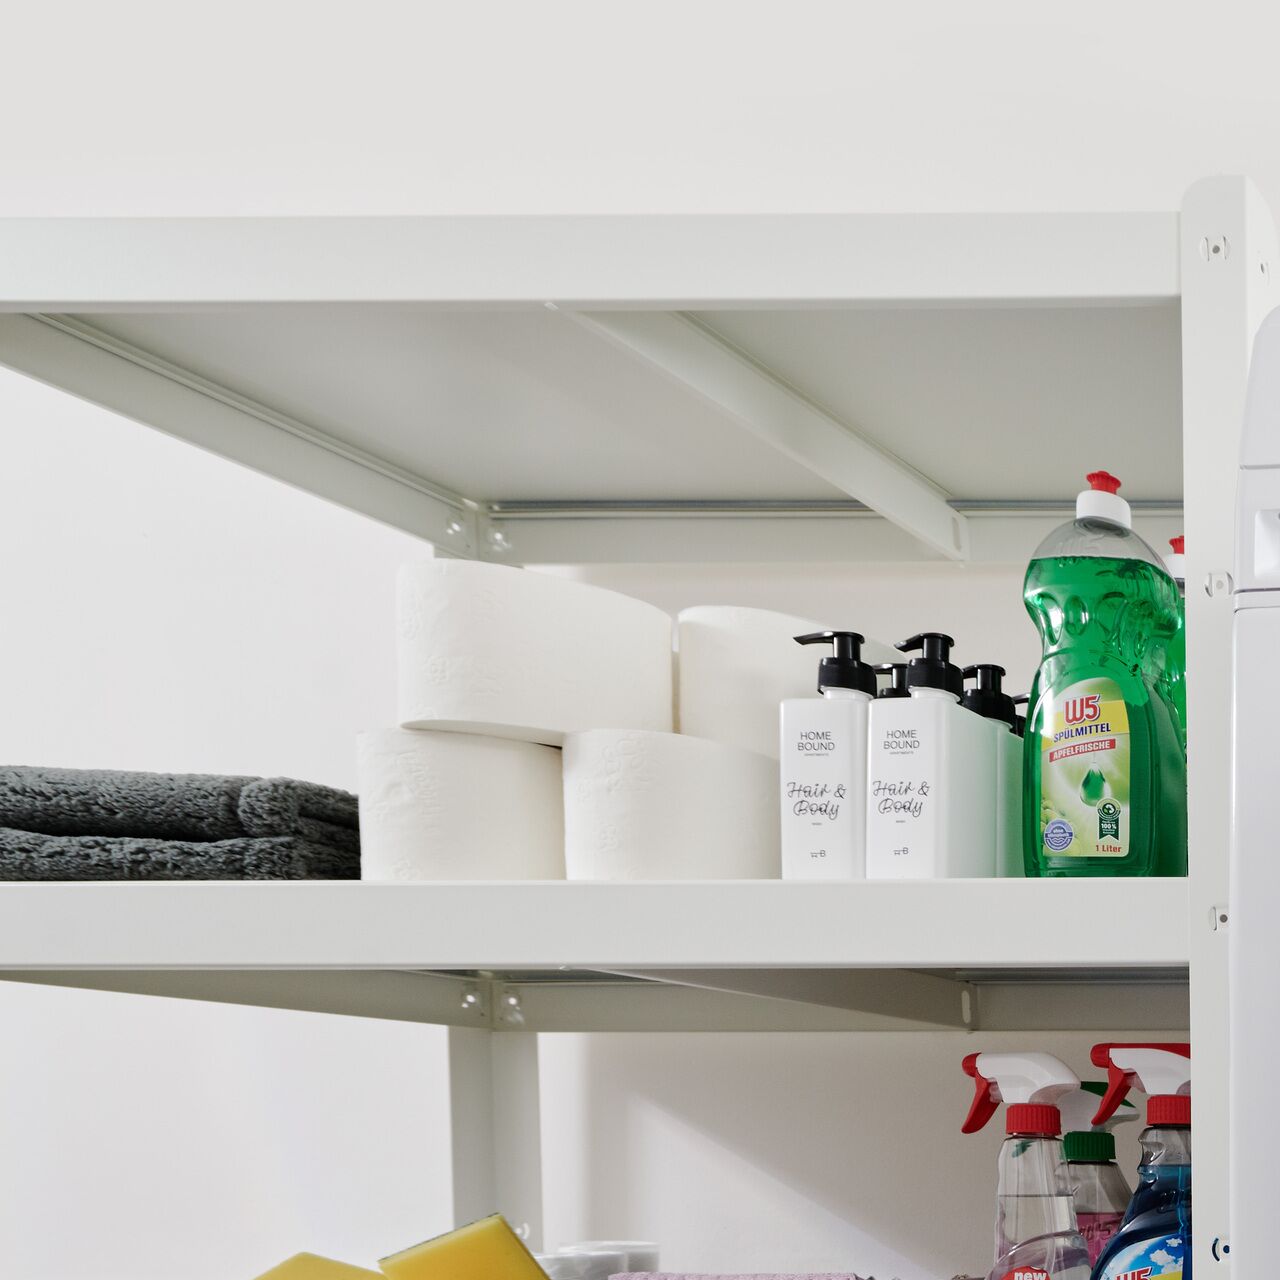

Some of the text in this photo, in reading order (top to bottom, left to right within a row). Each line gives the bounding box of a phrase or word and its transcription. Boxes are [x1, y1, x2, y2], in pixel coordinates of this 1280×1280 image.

[1064, 694, 1101, 725] W5
[800, 731, 832, 741] HOME
[886, 729, 917, 739] HOME
[1053, 723, 1111, 743] SPÜLMITTEL
[797, 742, 835, 751] BOUND
[883, 740, 920, 749] BOUND
[1053, 741, 1111, 760] APFELFRISCHE
[786, 781, 847, 799] Hair &
[872, 780, 930, 797] Hair &
[793, 799, 840, 821] Body
[878, 797, 923, 818] Body
[1102, 844, 1122, 853] Liter
